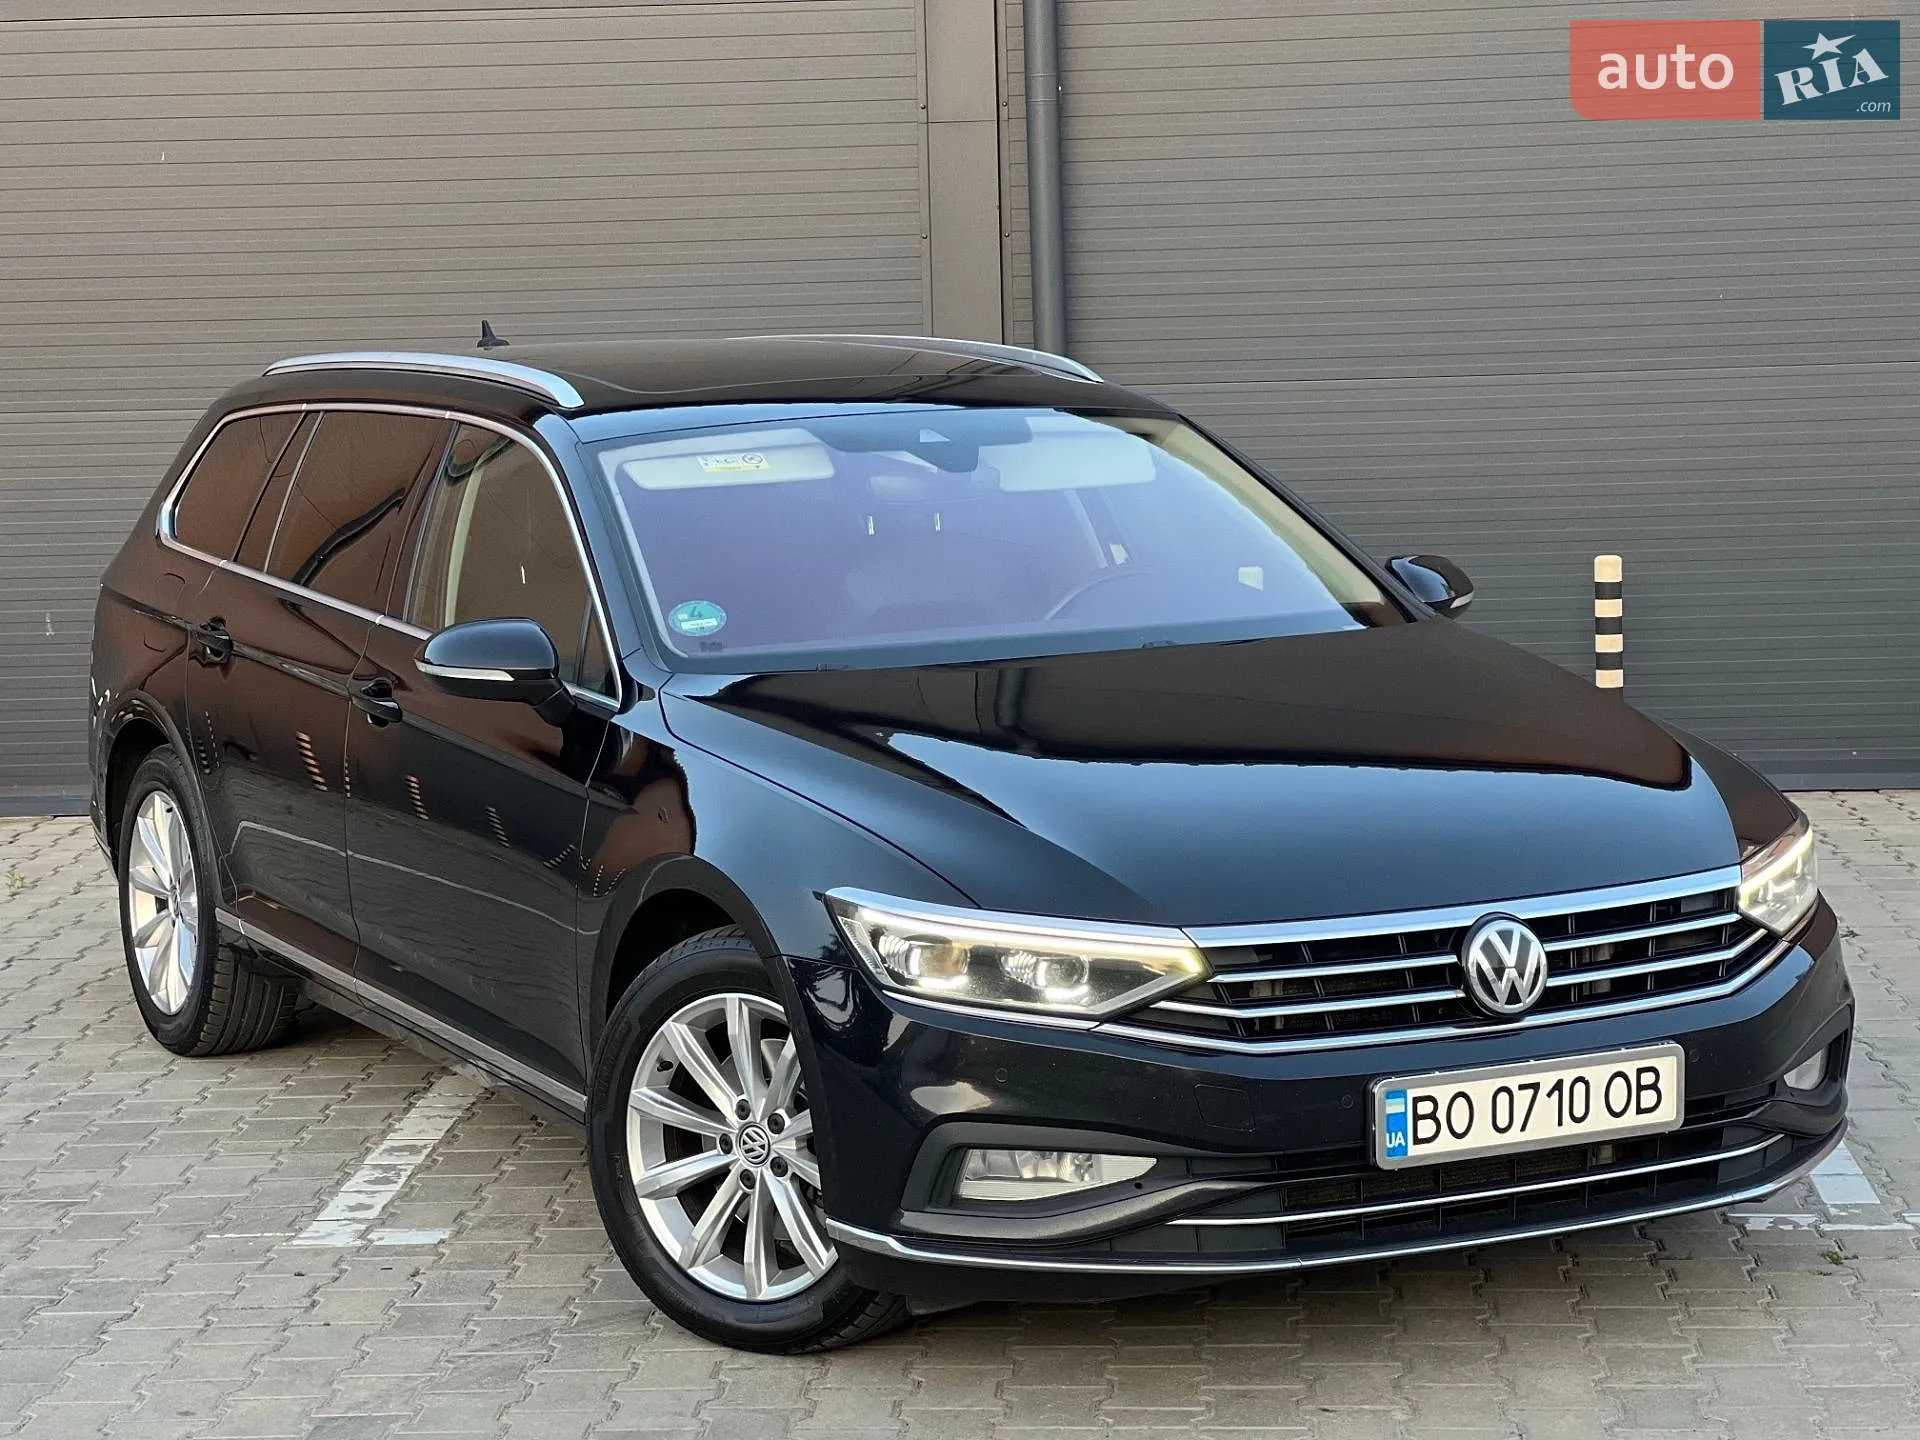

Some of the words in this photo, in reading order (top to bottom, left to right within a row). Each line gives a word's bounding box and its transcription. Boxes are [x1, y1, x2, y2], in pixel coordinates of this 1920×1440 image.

[1469, 921, 1546, 1012] VW
[1386, 1131, 1406, 1148] UA
[1412, 1091, 1474, 1145] BO
[1491, 1076, 1591, 1134] 0710
[1604, 1066, 1663, 1118] OB
